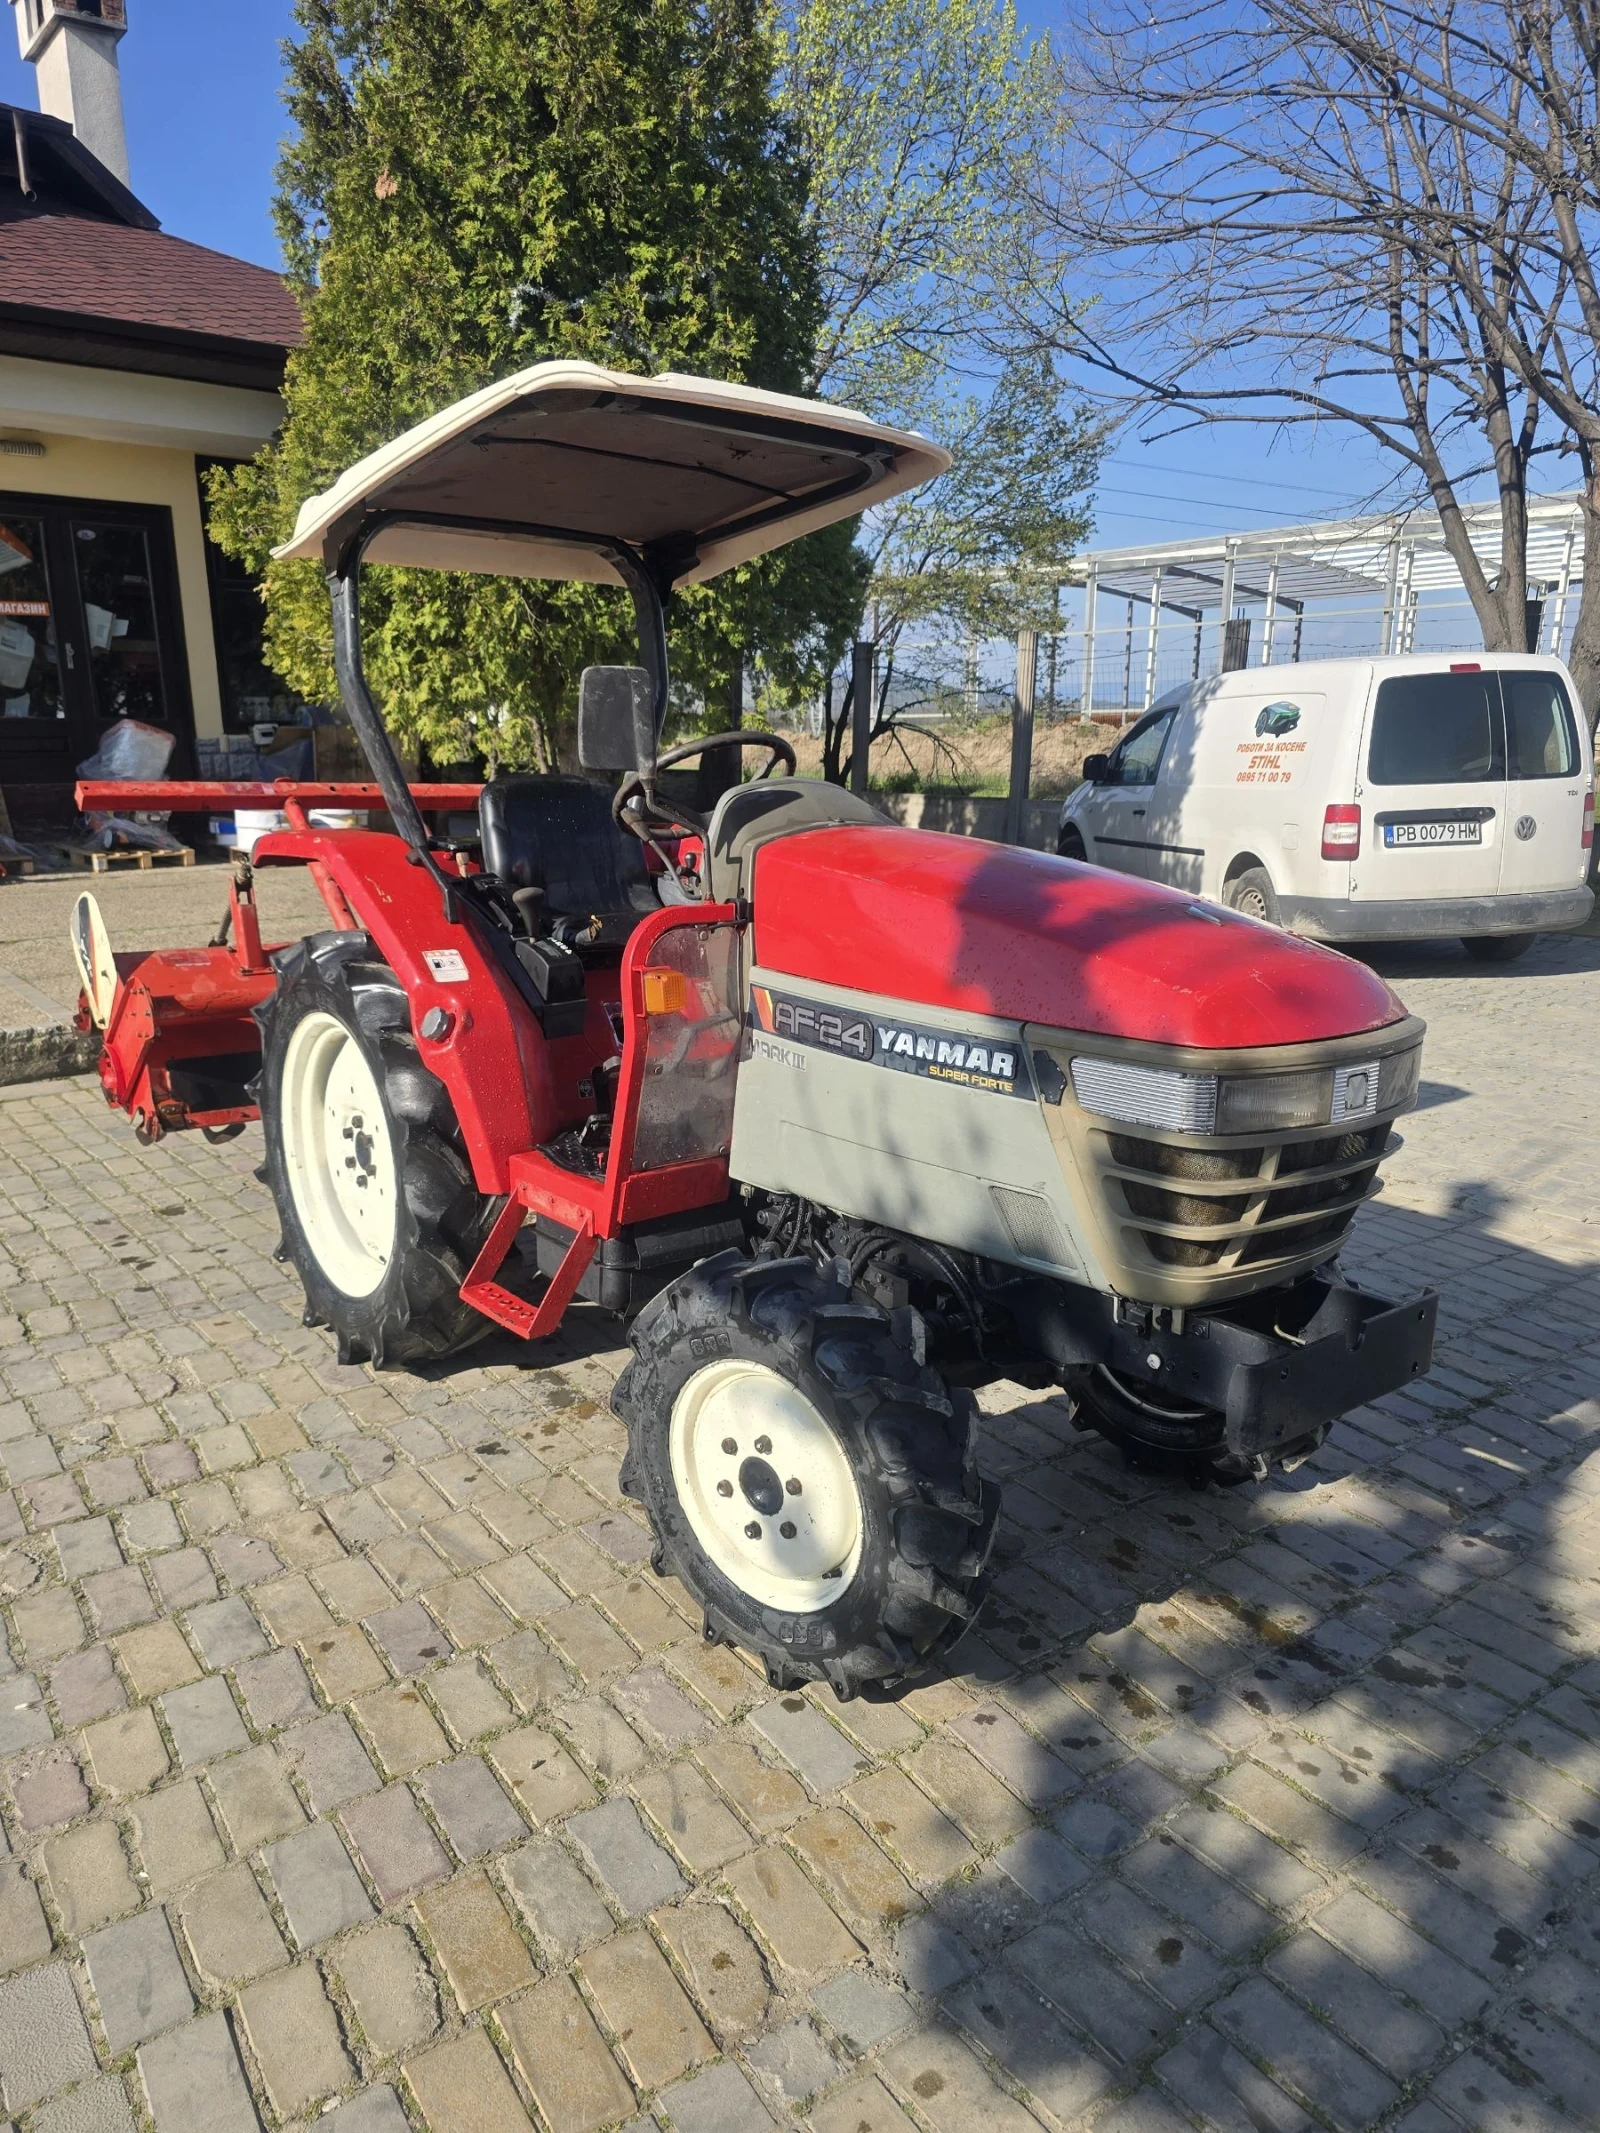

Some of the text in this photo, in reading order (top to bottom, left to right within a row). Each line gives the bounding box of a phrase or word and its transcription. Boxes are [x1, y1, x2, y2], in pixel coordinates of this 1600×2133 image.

[1236, 741, 1307, 753] РОБОТИ ЗА КОСЕНЕ
[1248, 755, 1281, 769] STIHL
[1236, 772, 1292, 783] 0895 71 00 79
[1396, 826, 1417, 841] PB
[1420, 824, 1456, 840] 0079
[775, 1001, 868, 1055] AF-24
[877, 1026, 1015, 1077] YANMAR
[928, 1065, 1014, 1092] SUPER FORTE
